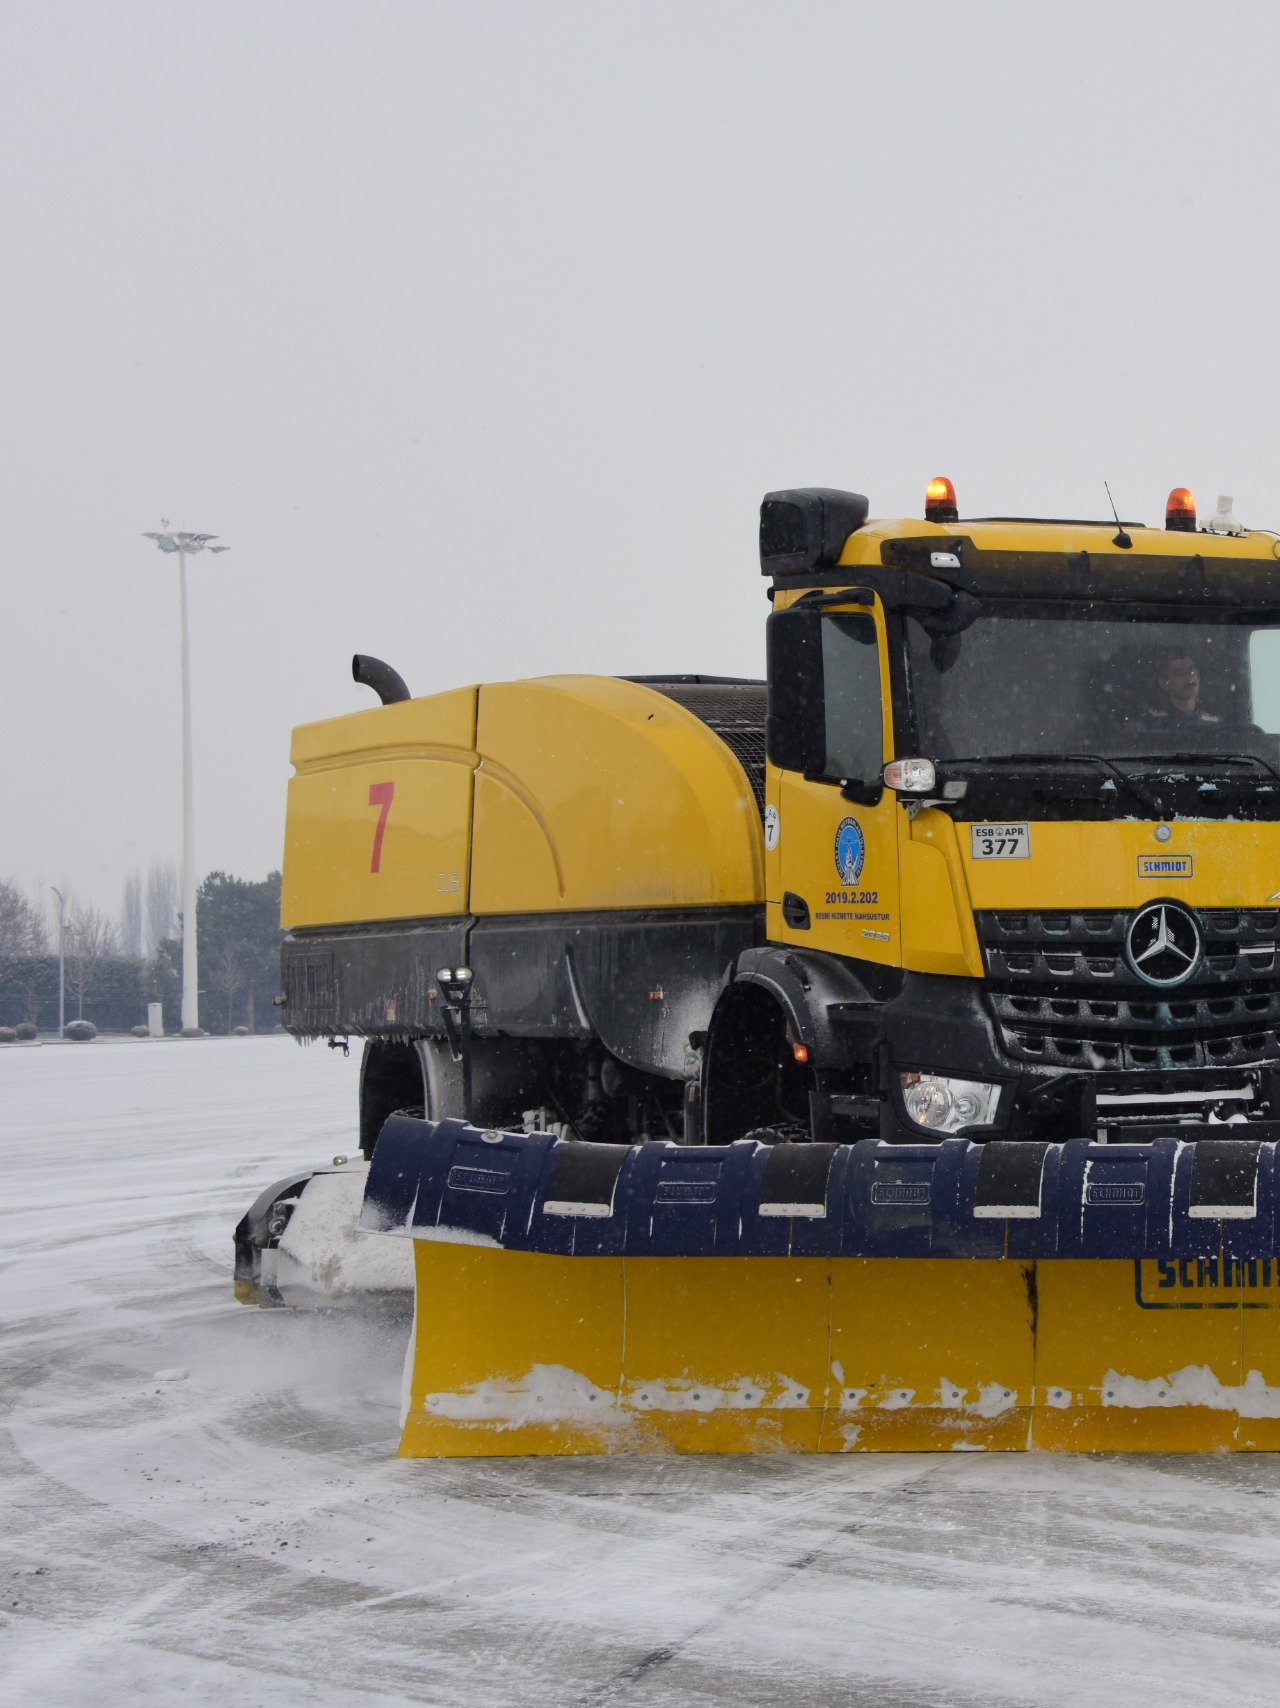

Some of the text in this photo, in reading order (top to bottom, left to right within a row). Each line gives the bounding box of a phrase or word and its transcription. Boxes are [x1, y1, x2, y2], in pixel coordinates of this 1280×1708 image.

[368, 781, 395, 873] 7
[767, 824, 774, 842] 7
[976, 827, 1025, 837] ESB APR
[982, 838, 1019, 856] 377
[1143, 861, 1187, 872] SCHMIDT
[825, 891, 879, 904] 2019.2.202
